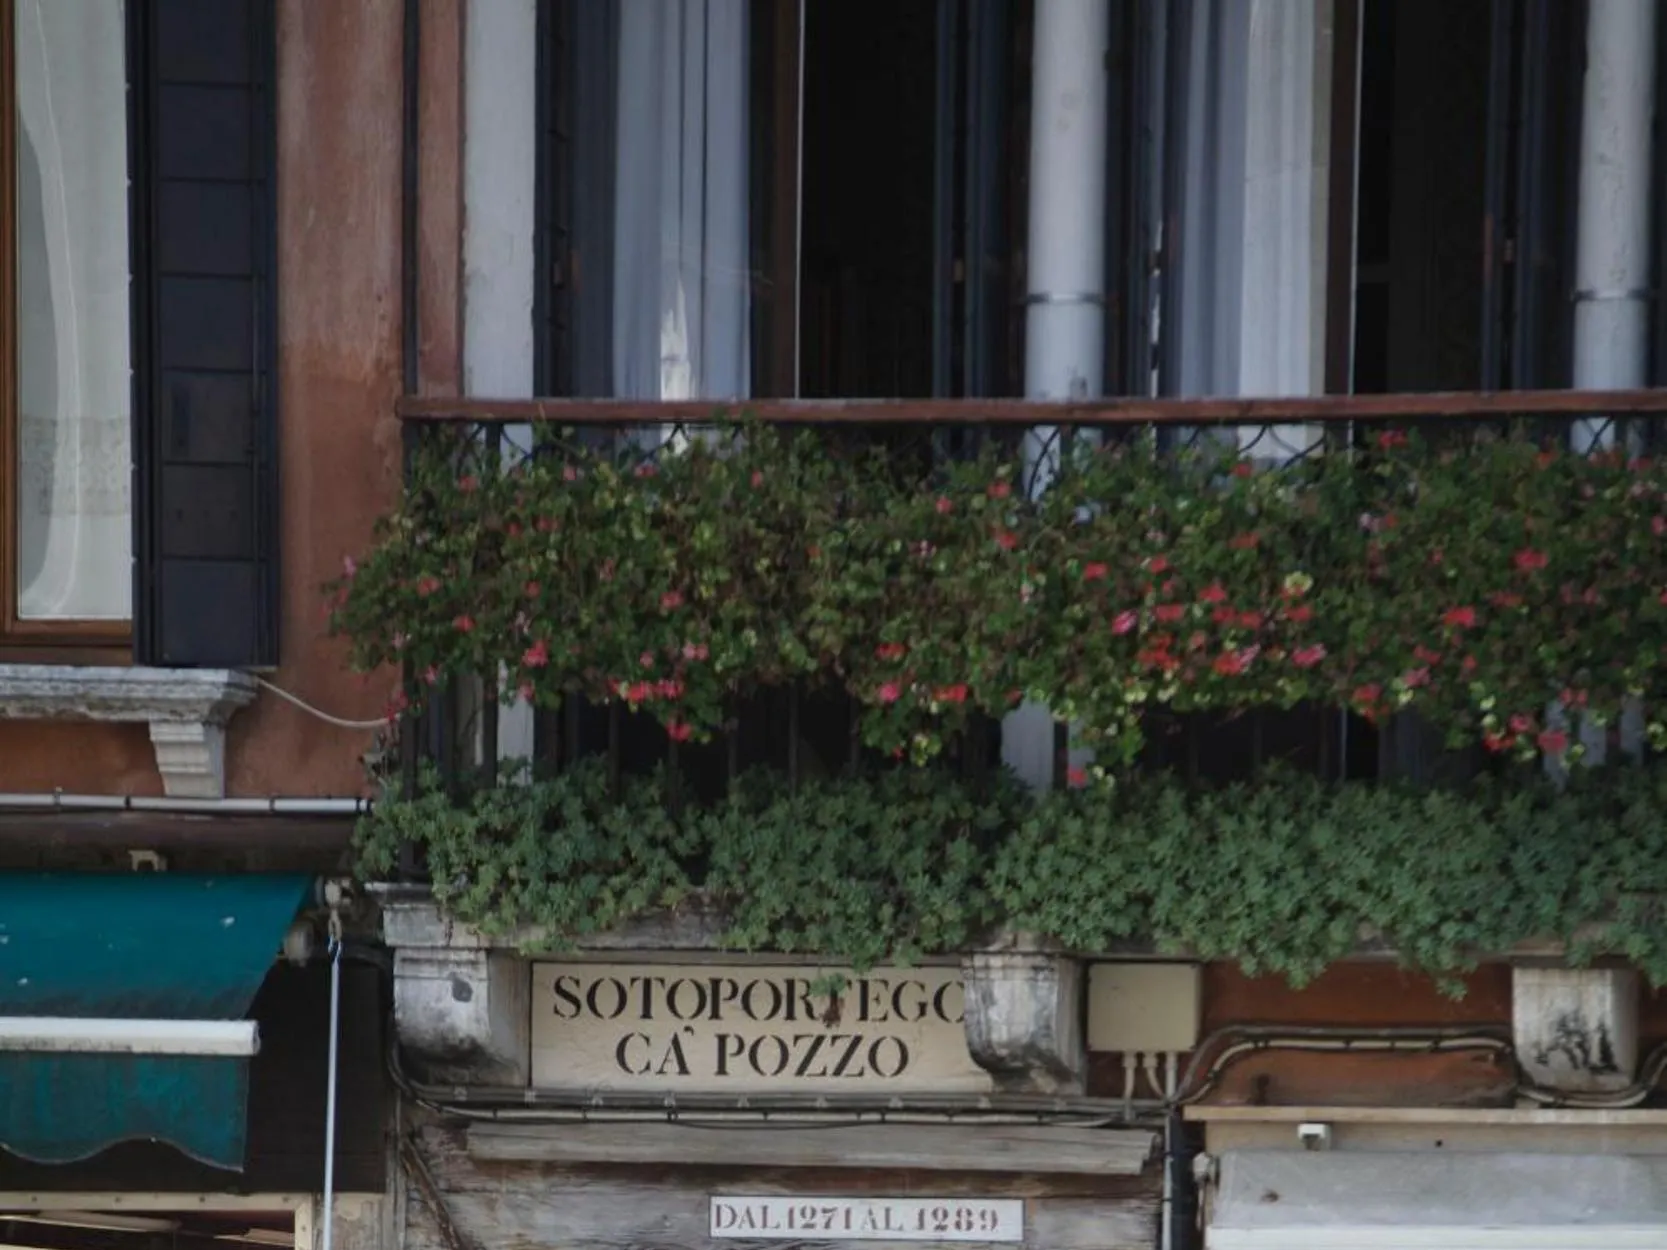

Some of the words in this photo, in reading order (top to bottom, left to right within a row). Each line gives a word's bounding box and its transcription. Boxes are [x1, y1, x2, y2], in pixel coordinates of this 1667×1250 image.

[714, 1034, 910, 1078] POZZO
[714, 1204, 781, 1230] DAL
[862, 1206, 904, 1231] AL
[916, 1206, 999, 1232] 1289
